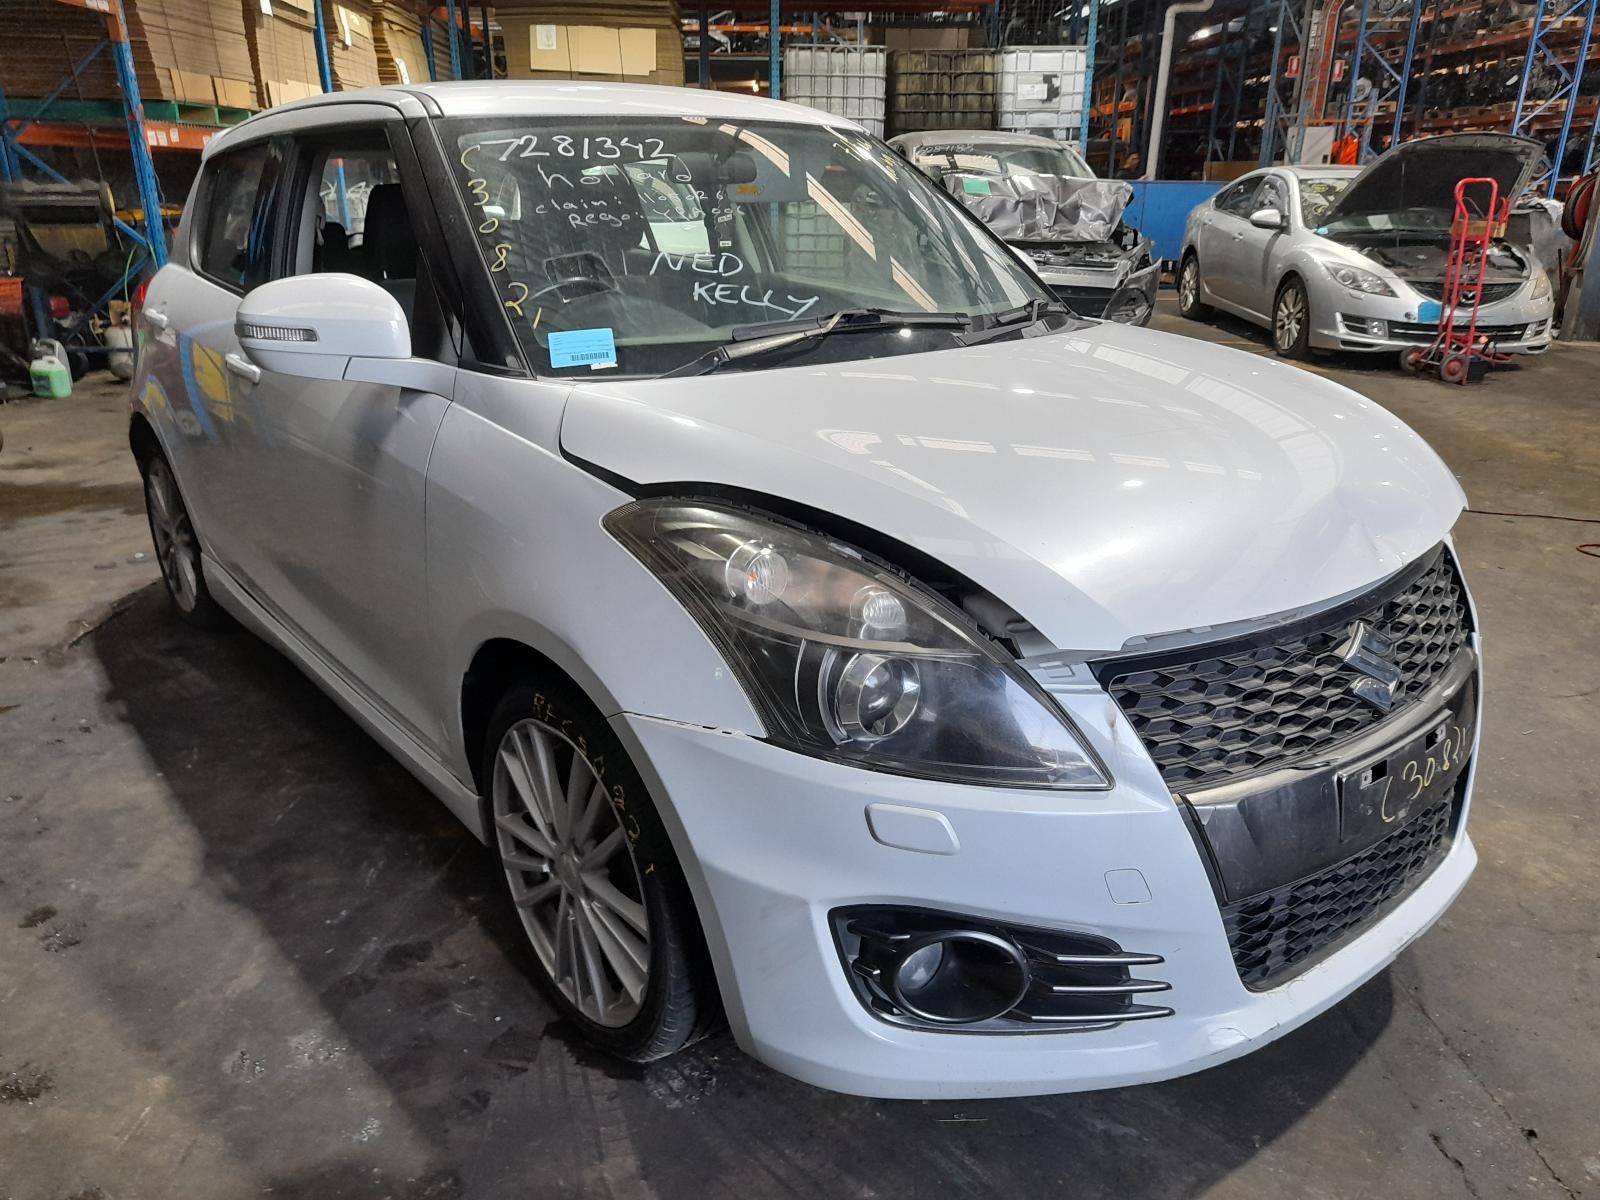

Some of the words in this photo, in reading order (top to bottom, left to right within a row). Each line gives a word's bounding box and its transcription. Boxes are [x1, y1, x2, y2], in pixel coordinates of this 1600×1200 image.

[479, 134, 677, 162] 7281342
[649, 251, 744, 277] NED
[692, 281, 820, 321] KELLY
